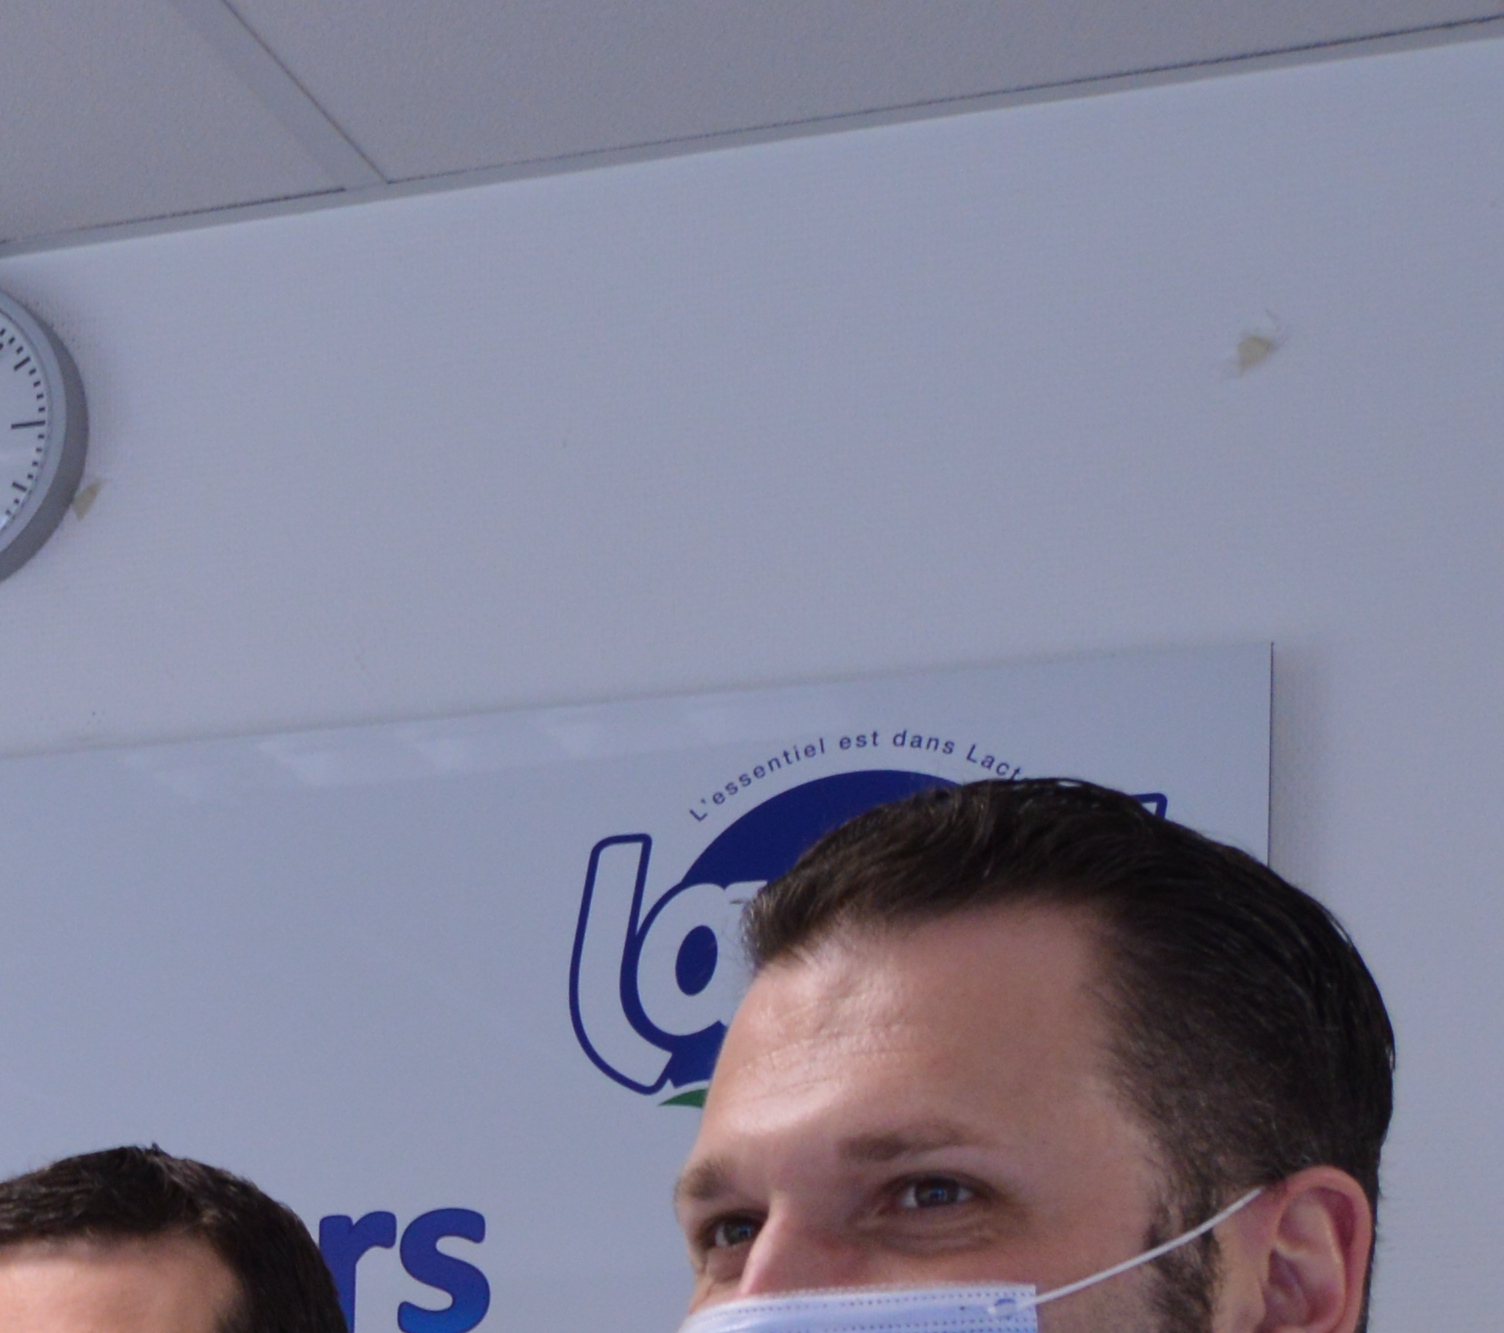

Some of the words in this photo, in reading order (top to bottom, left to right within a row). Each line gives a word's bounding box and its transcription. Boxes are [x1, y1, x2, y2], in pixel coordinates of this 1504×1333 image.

[689, 737, 825, 822] L'essentiel
[839, 730, 879, 750] est
[892, 730, 955, 755] dans
[966, 744, 1022, 781] Lact
